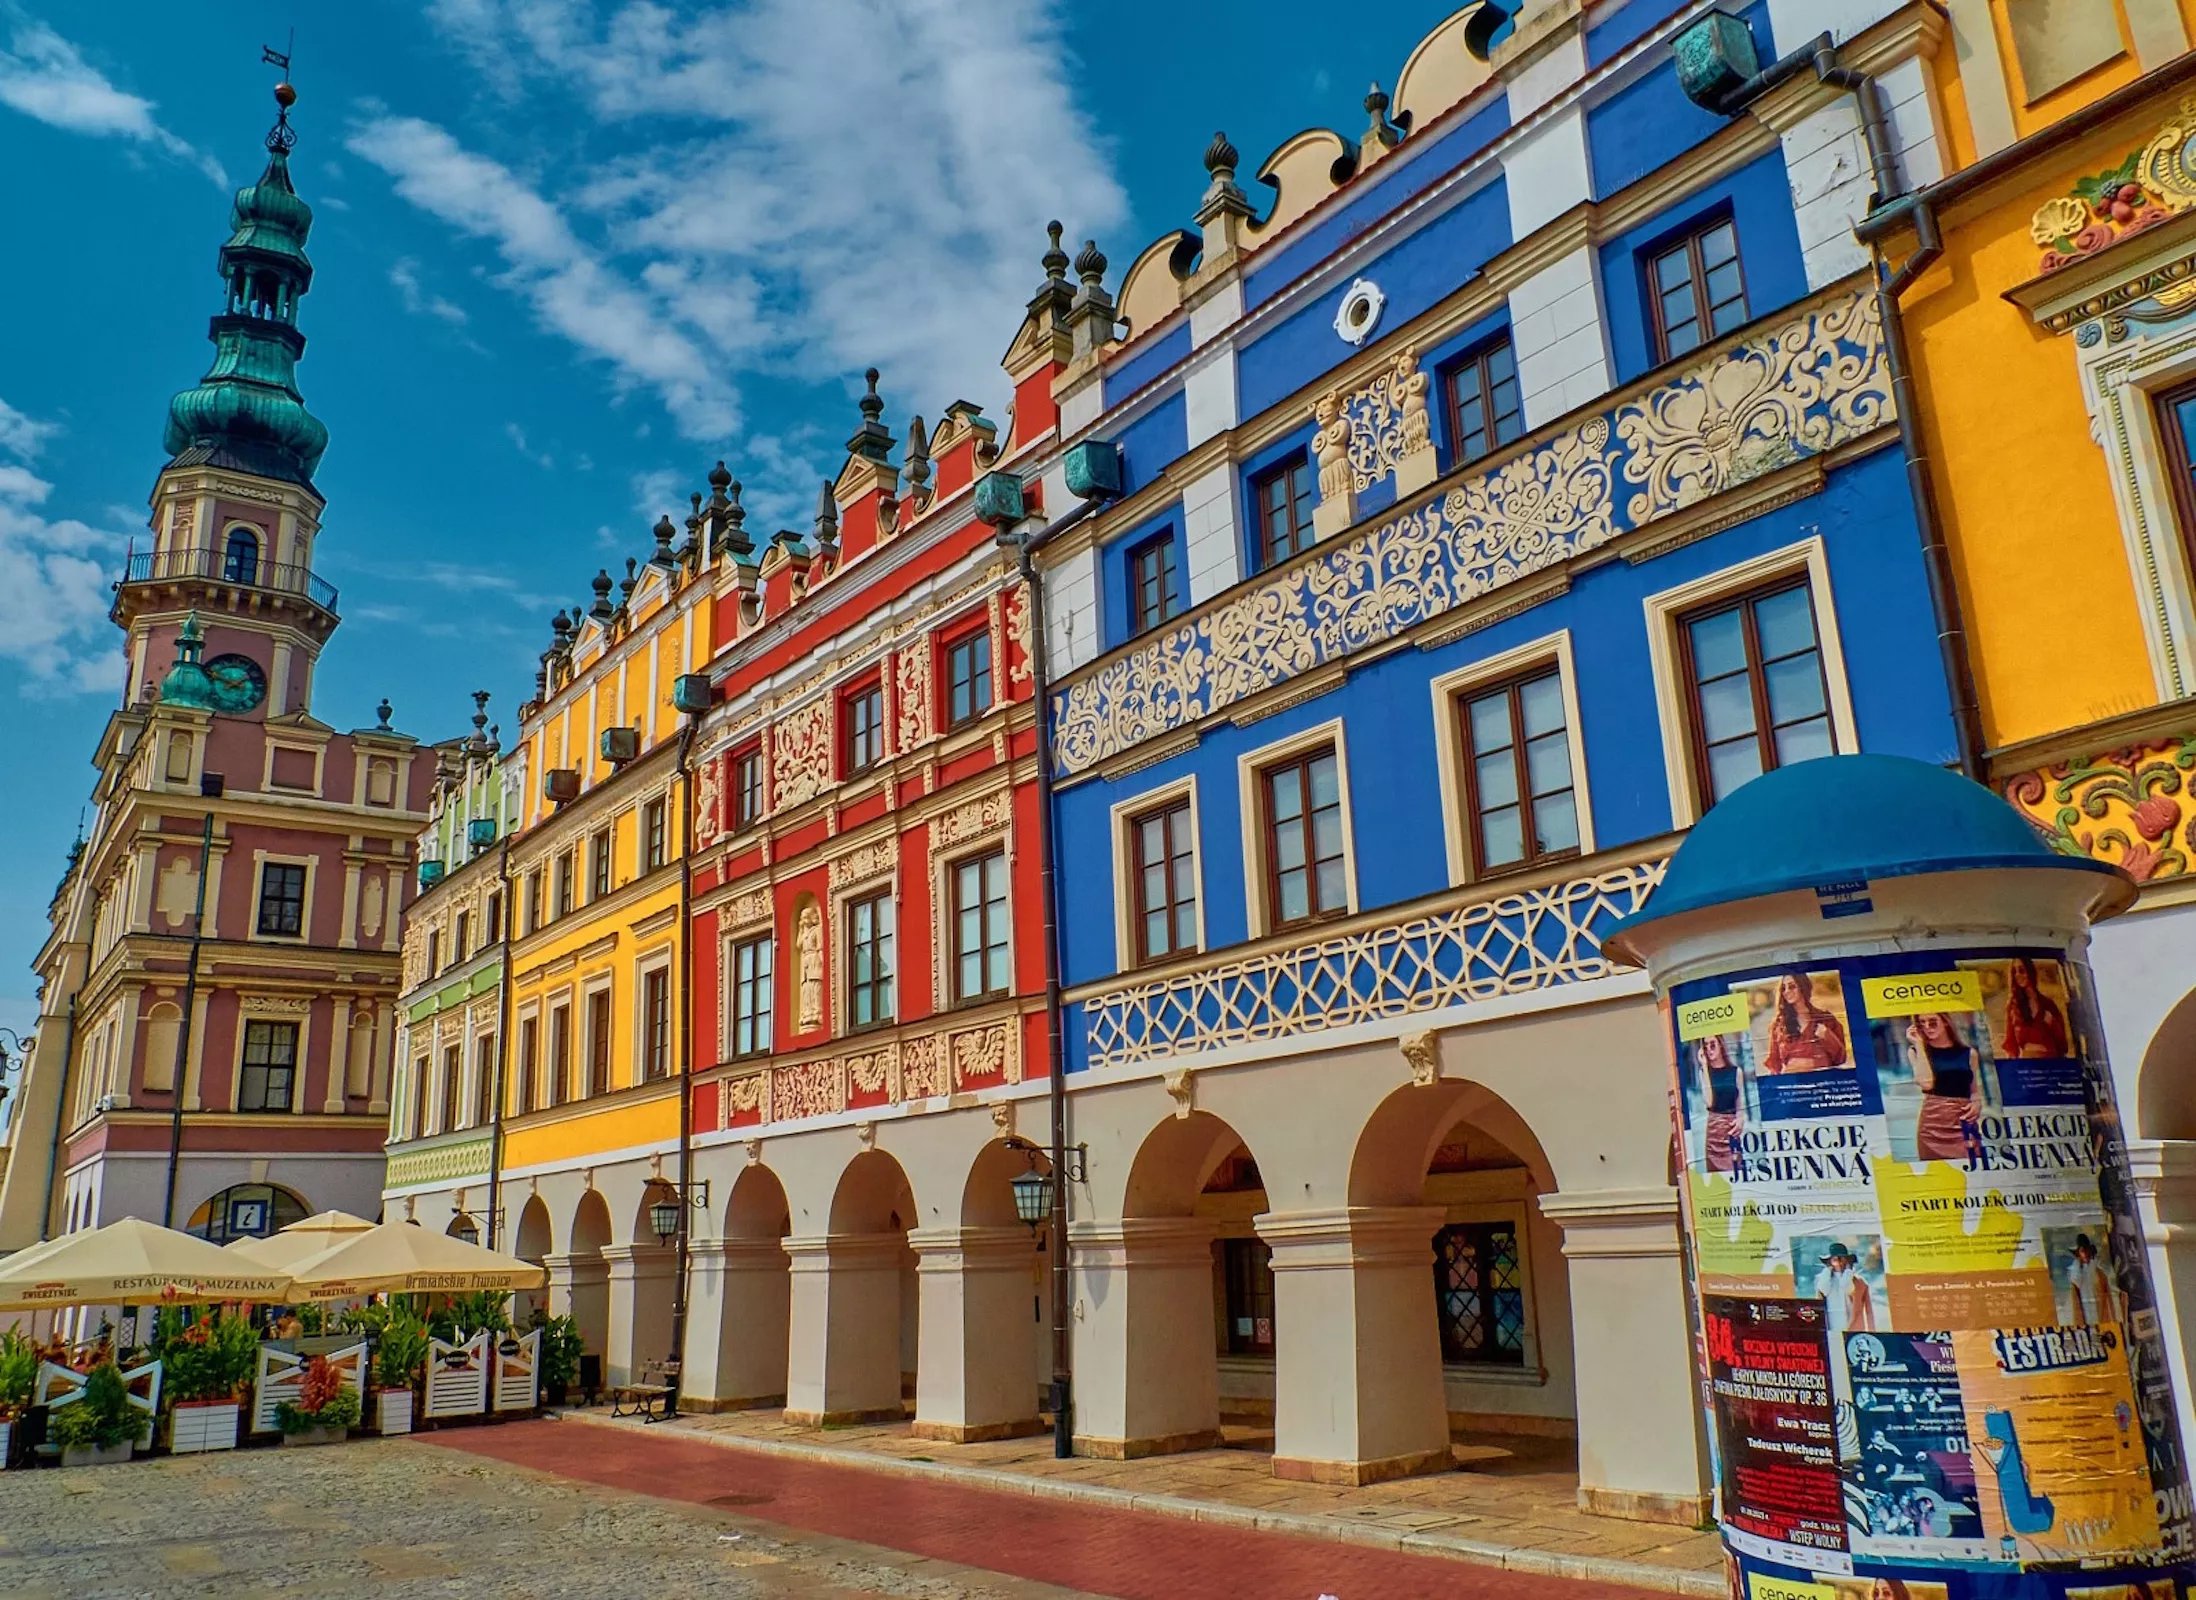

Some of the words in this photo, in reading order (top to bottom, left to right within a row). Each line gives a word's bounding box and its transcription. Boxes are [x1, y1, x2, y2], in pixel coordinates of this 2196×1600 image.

[1883, 981, 1962, 1000] ceneco
[1686, 1004, 1734, 1025] ceneco
[1728, 1125, 1868, 1155] KOLEKCJĘ
[1729, 1152, 1872, 1186] JESIENNĄ
[1701, 1206, 1722, 1218] START
[1723, 1204, 1776, 1217] KOLEKCJI
[1778, 1203, 1797, 1216] OD
[1900, 1198, 1951, 1212] START
[1954, 1194, 2024, 1209] KOLEKCJI
[2026, 1193, 2046, 1206] OD
[243, 1206, 255, 1226] i
[206, 1278, 275, 1291] MUZEALNA
[404, 1274, 466, 1290] Ormiańskie
[22, 1287, 78, 1300] ZWIERZYNIEC
[310, 1286, 358, 1298] ZWIERZYNIEC
[1777, 1341, 1818, 1358] WYBUCHU
[2003, 1327, 2107, 1370] ESTRADA
[1789, 1371, 1826, 1390] GÓRECKI
[1815, 1391, 1828, 1407] 36
[1777, 1416, 1799, 1429] Ewa
[1800, 1419, 1831, 1432] Tracz
[1747, 1437, 1782, 1451] Tadeusz
[1782, 1442, 1833, 1458] Wicherek
[1789, 1528, 1814, 1547] WSTĘP
[1814, 1532, 1842, 1549] WOLNY
